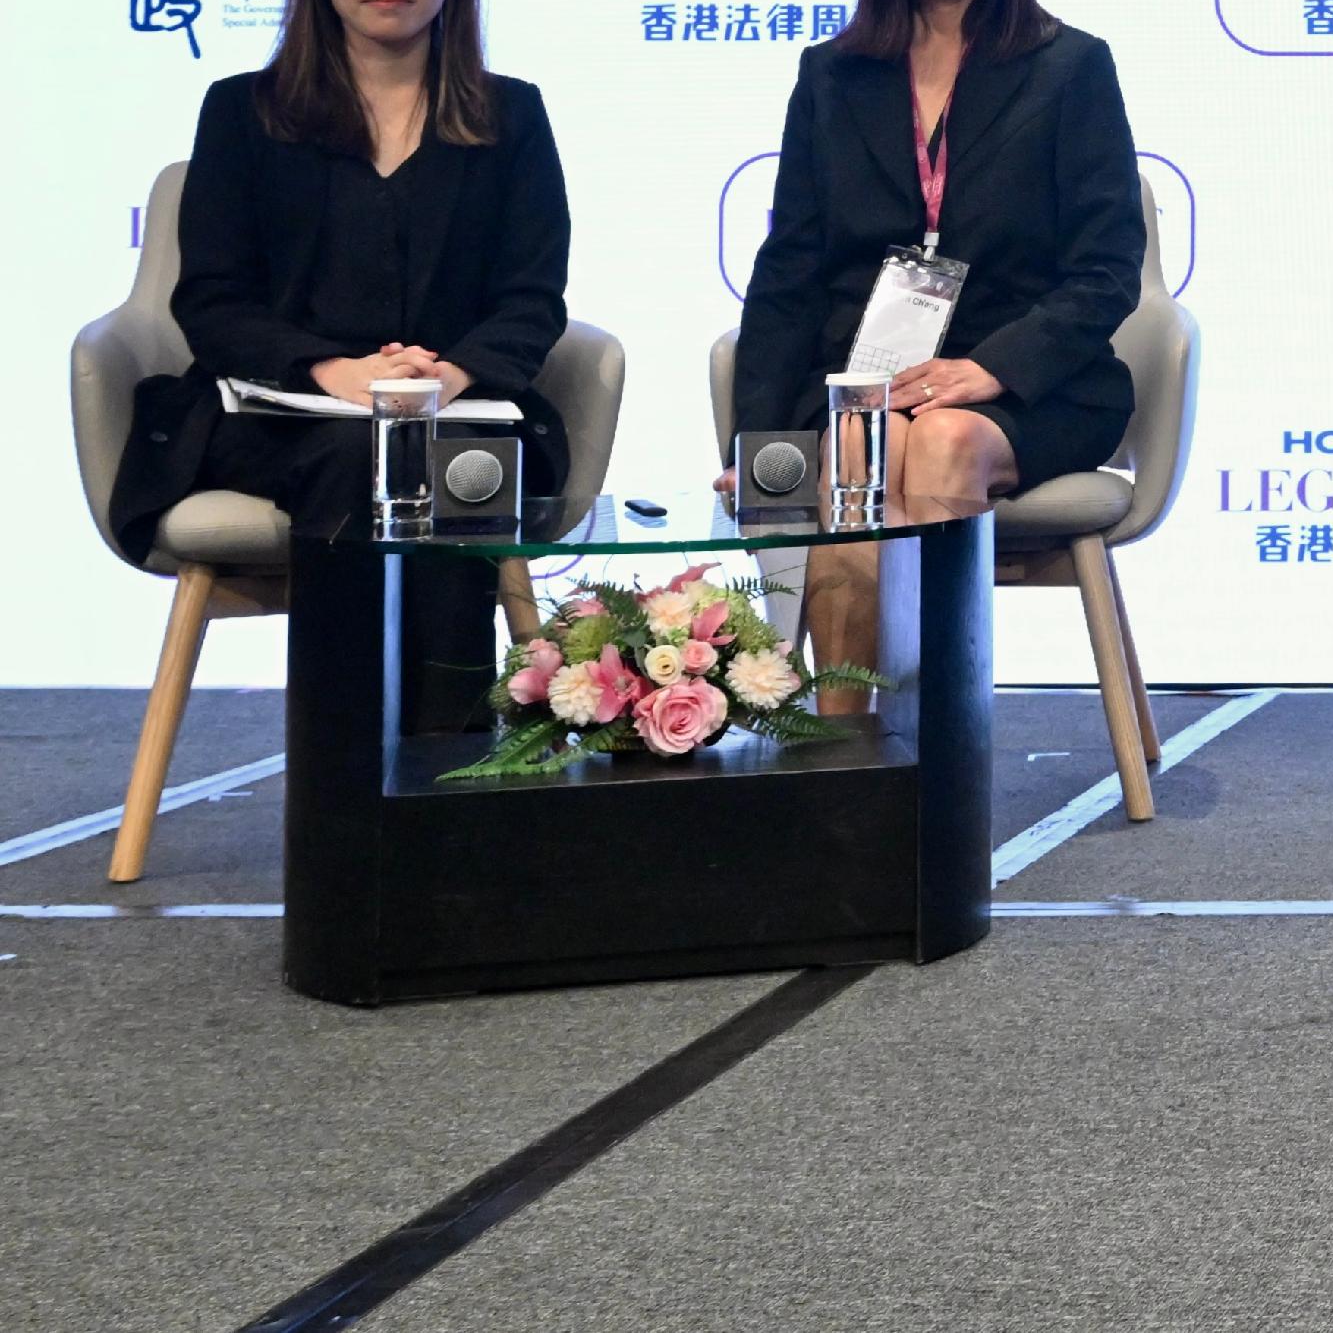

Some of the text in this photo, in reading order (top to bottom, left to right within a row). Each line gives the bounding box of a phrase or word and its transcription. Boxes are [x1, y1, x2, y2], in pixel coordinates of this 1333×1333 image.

[641, 3, 847, 41] 香港法律周
